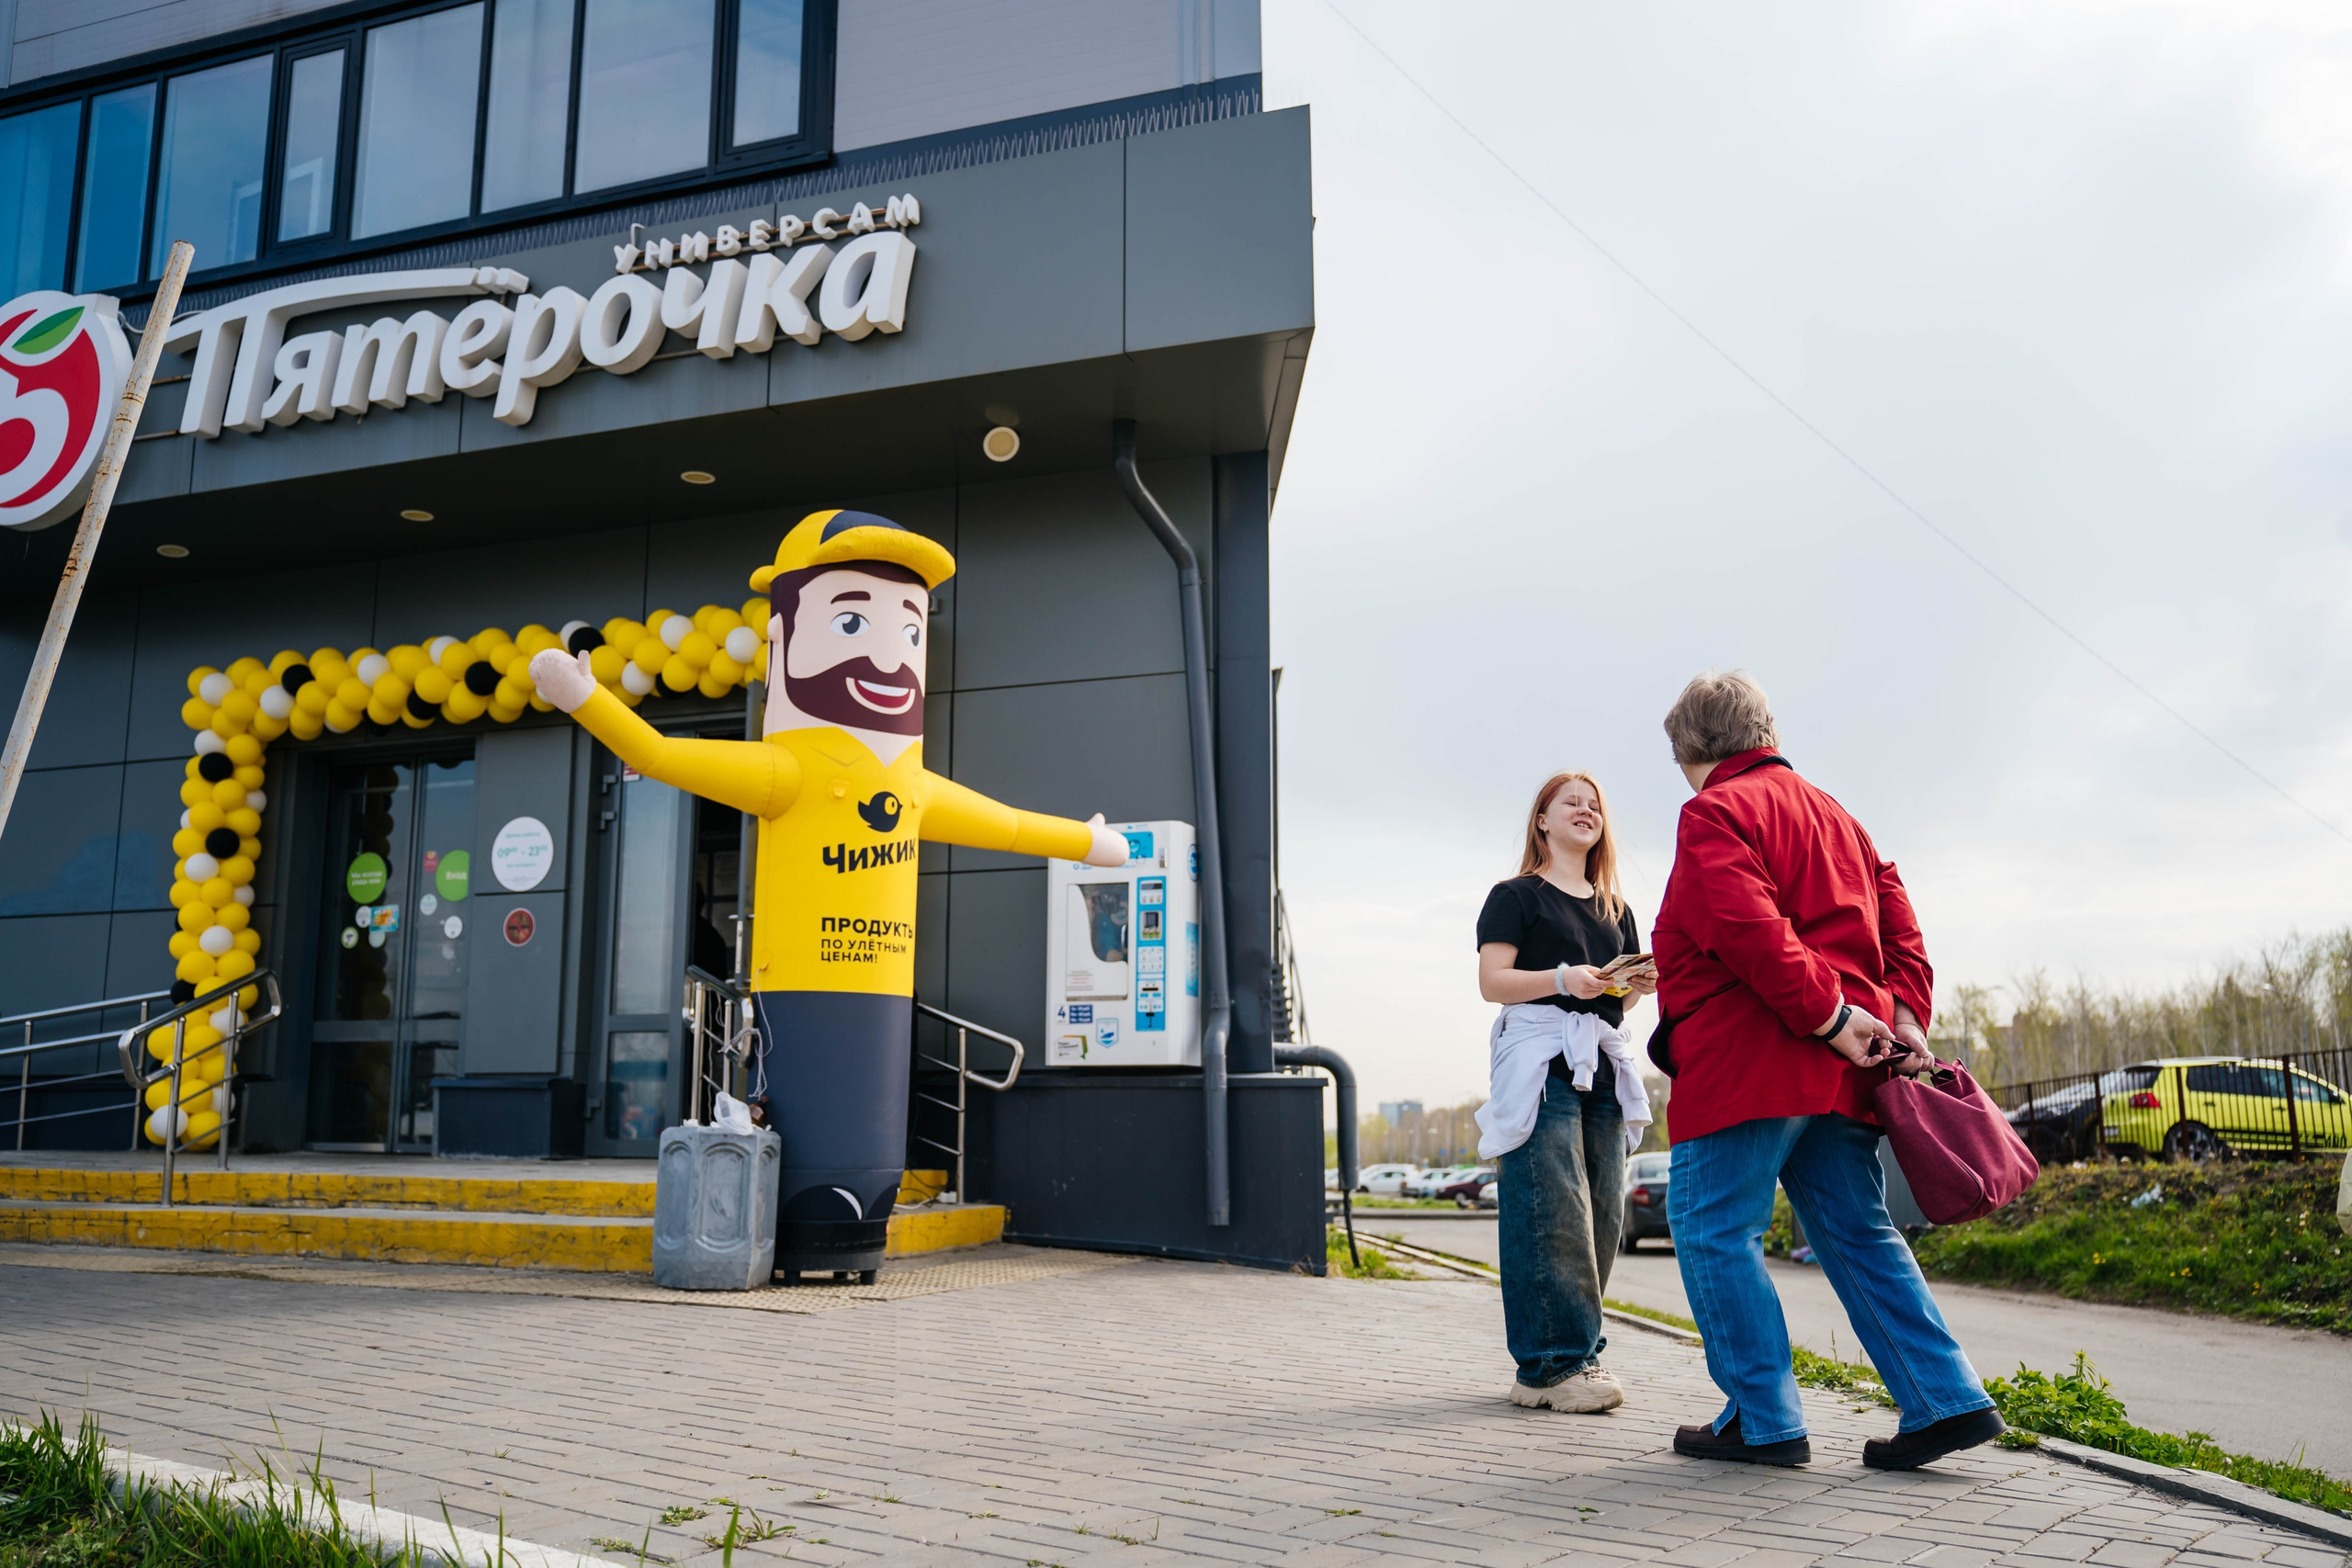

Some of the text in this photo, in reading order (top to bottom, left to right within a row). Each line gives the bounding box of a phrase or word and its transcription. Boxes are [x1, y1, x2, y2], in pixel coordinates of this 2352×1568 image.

[614, 193, 921, 273] УНИВЕРСАМ
[821, 938, 907, 953] ПО УЛЁТНЫМ
[820, 951, 877, 963] ЦЕНАМ!
